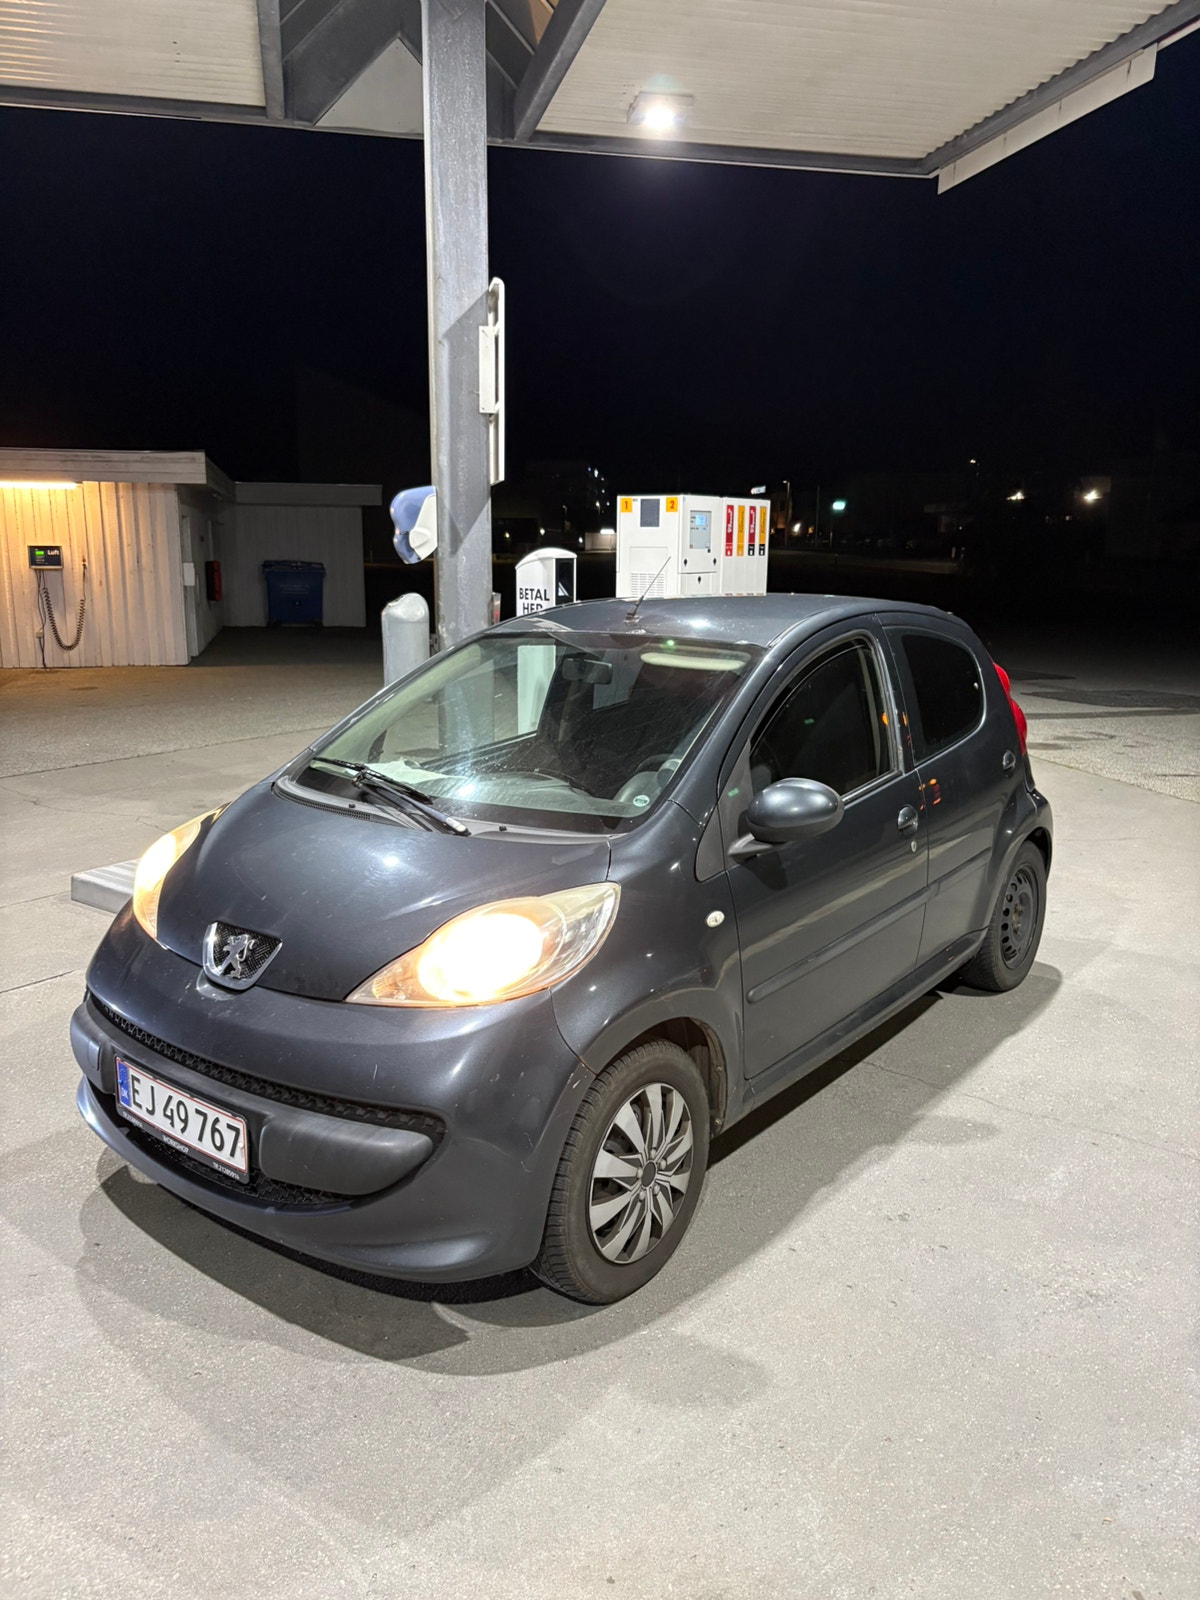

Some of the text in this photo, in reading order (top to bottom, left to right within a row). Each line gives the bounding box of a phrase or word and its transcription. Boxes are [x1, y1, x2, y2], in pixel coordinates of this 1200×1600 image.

[519, 587, 550, 601] BETAL
[131, 1074, 156, 1116] EJ
[163, 1094, 189, 1134] 49
[195, 1107, 241, 1158] 767
